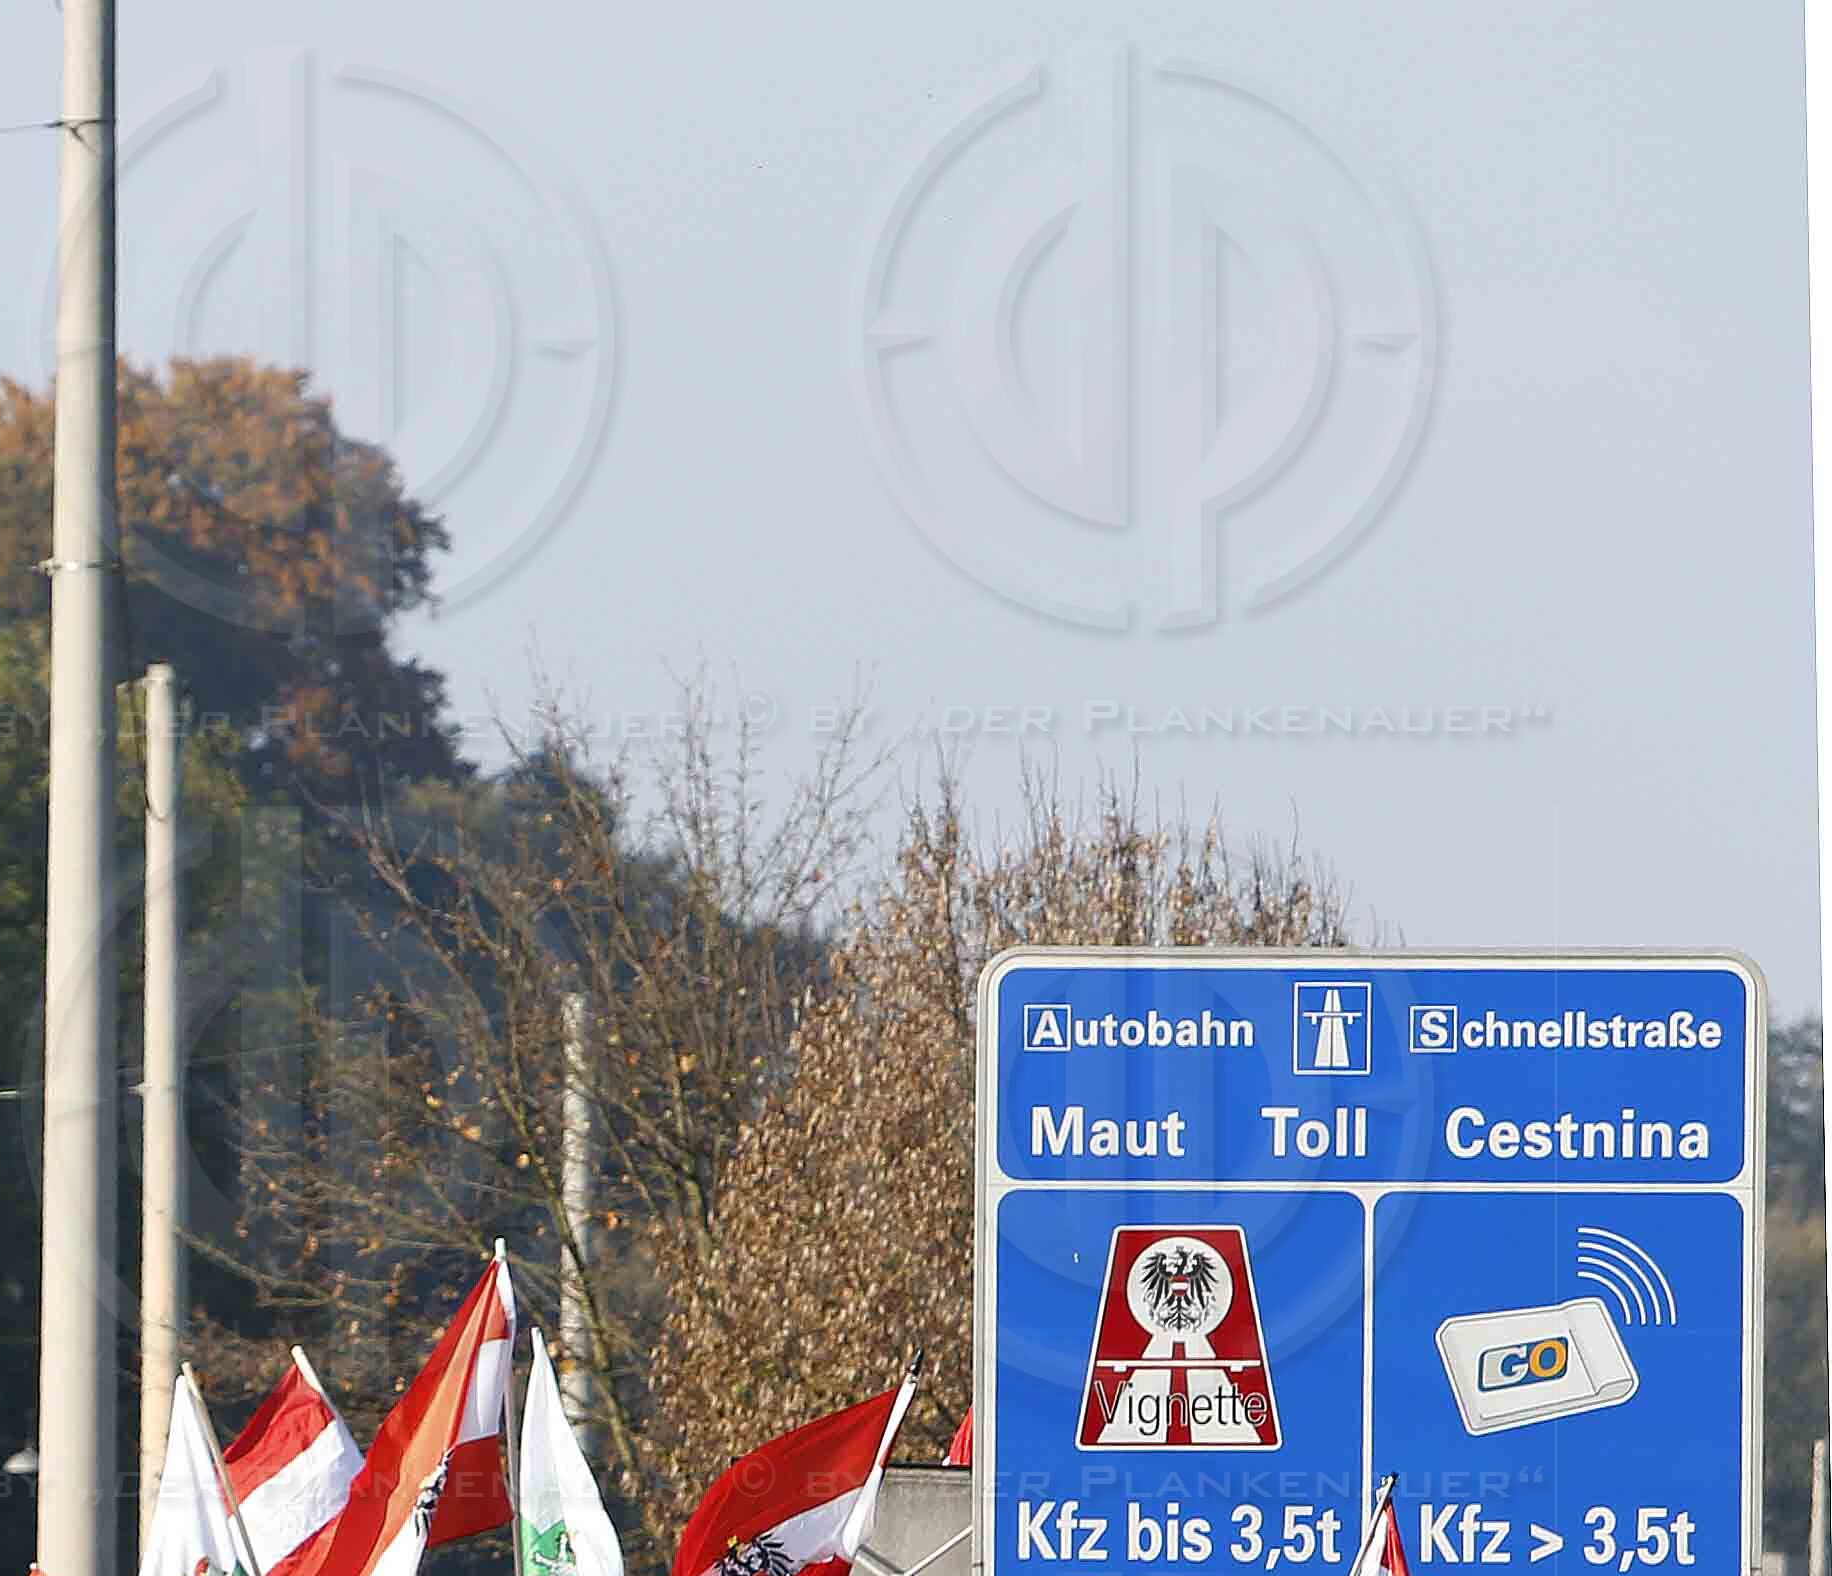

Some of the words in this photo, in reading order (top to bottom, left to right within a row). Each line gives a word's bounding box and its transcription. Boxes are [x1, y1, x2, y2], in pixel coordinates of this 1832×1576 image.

[1030, 1010, 1254, 1048] Autobahn
[1419, 1010, 1723, 1049] Schnellstraße
[1031, 1107, 1185, 1157] Maut
[1261, 1108, 1366, 1158] Toll
[1445, 1108, 1709, 1159] Cestnina
[1486, 1337, 1568, 1386] GO
[1094, 1380, 1268, 1437] Vignette
[1018, 1501, 1108, 1560] Kfz
[1128, 1503, 1213, 1562] bis
[1230, 1505, 1342, 1570] 3,5t
[1420, 1505, 1511, 1563] Kfz
[1583, 1507, 1696, 1572] 3,5t
